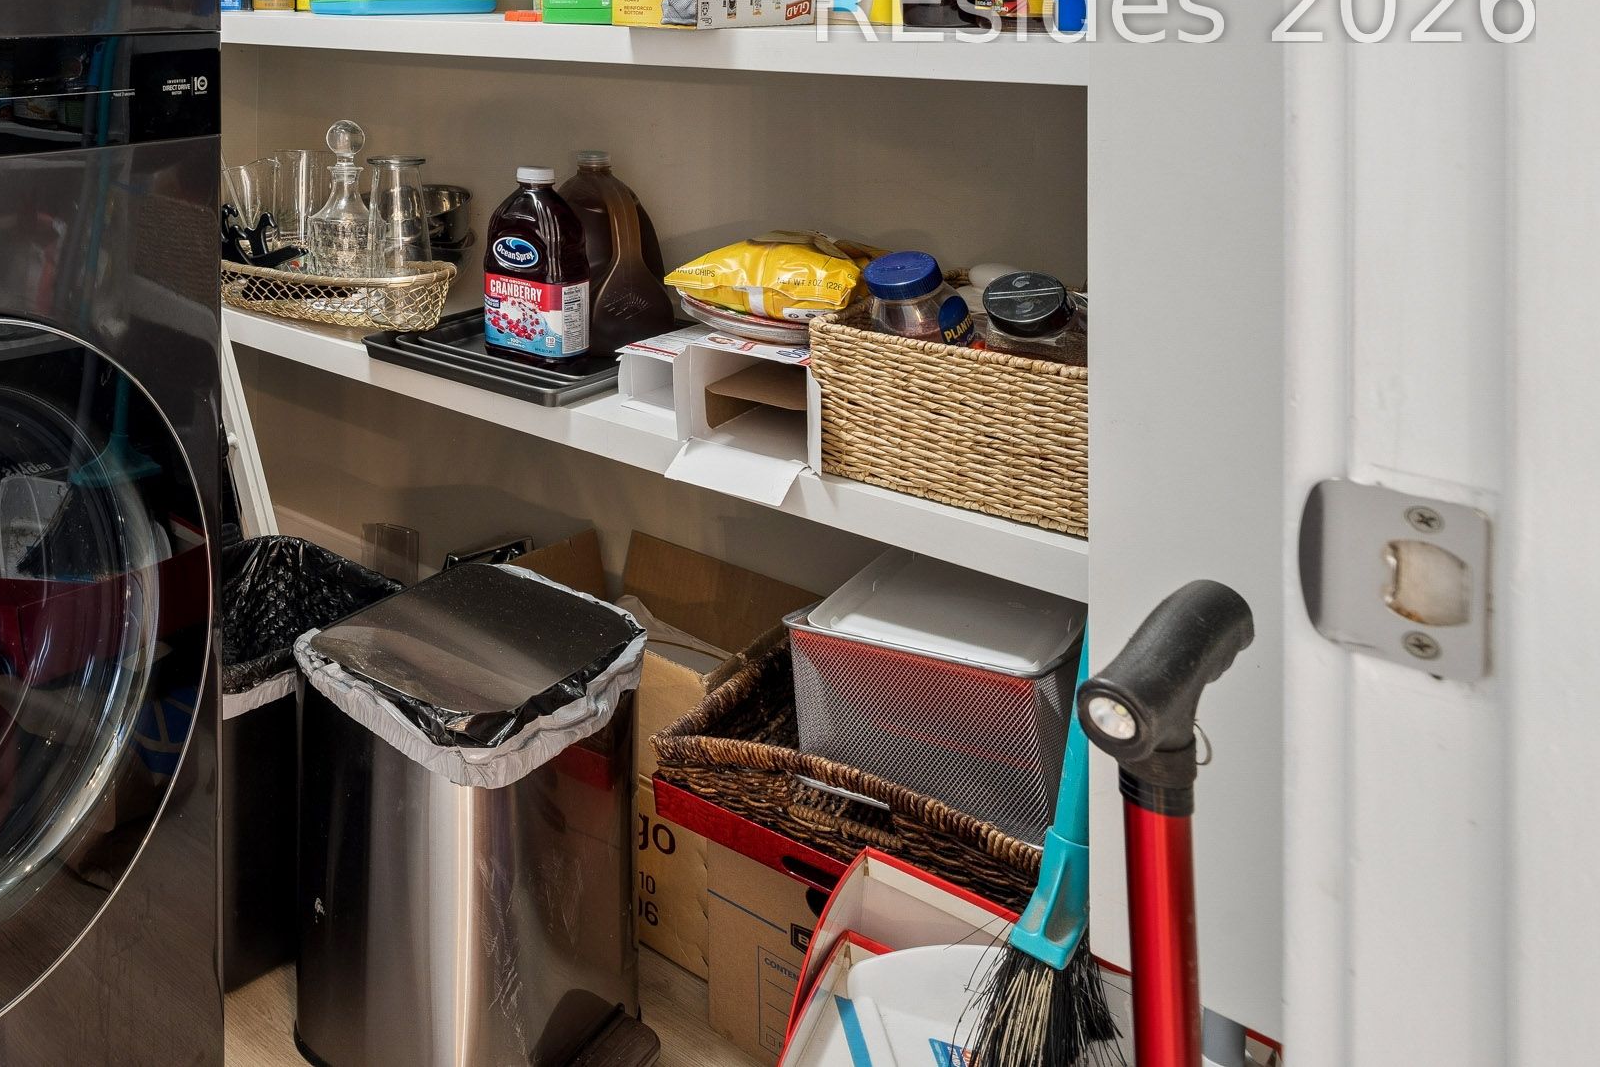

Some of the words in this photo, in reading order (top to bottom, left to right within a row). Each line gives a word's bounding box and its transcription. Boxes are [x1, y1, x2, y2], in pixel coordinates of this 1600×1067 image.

[786, 0, 811, 16] GLAD
[194, 76, 208, 91] 10
[496, 244, 516, 259] Ocean
[516, 251, 535, 262] Spray
[695, 268, 716, 278] CHIPS
[490, 279, 542, 302] CRANBERRY
